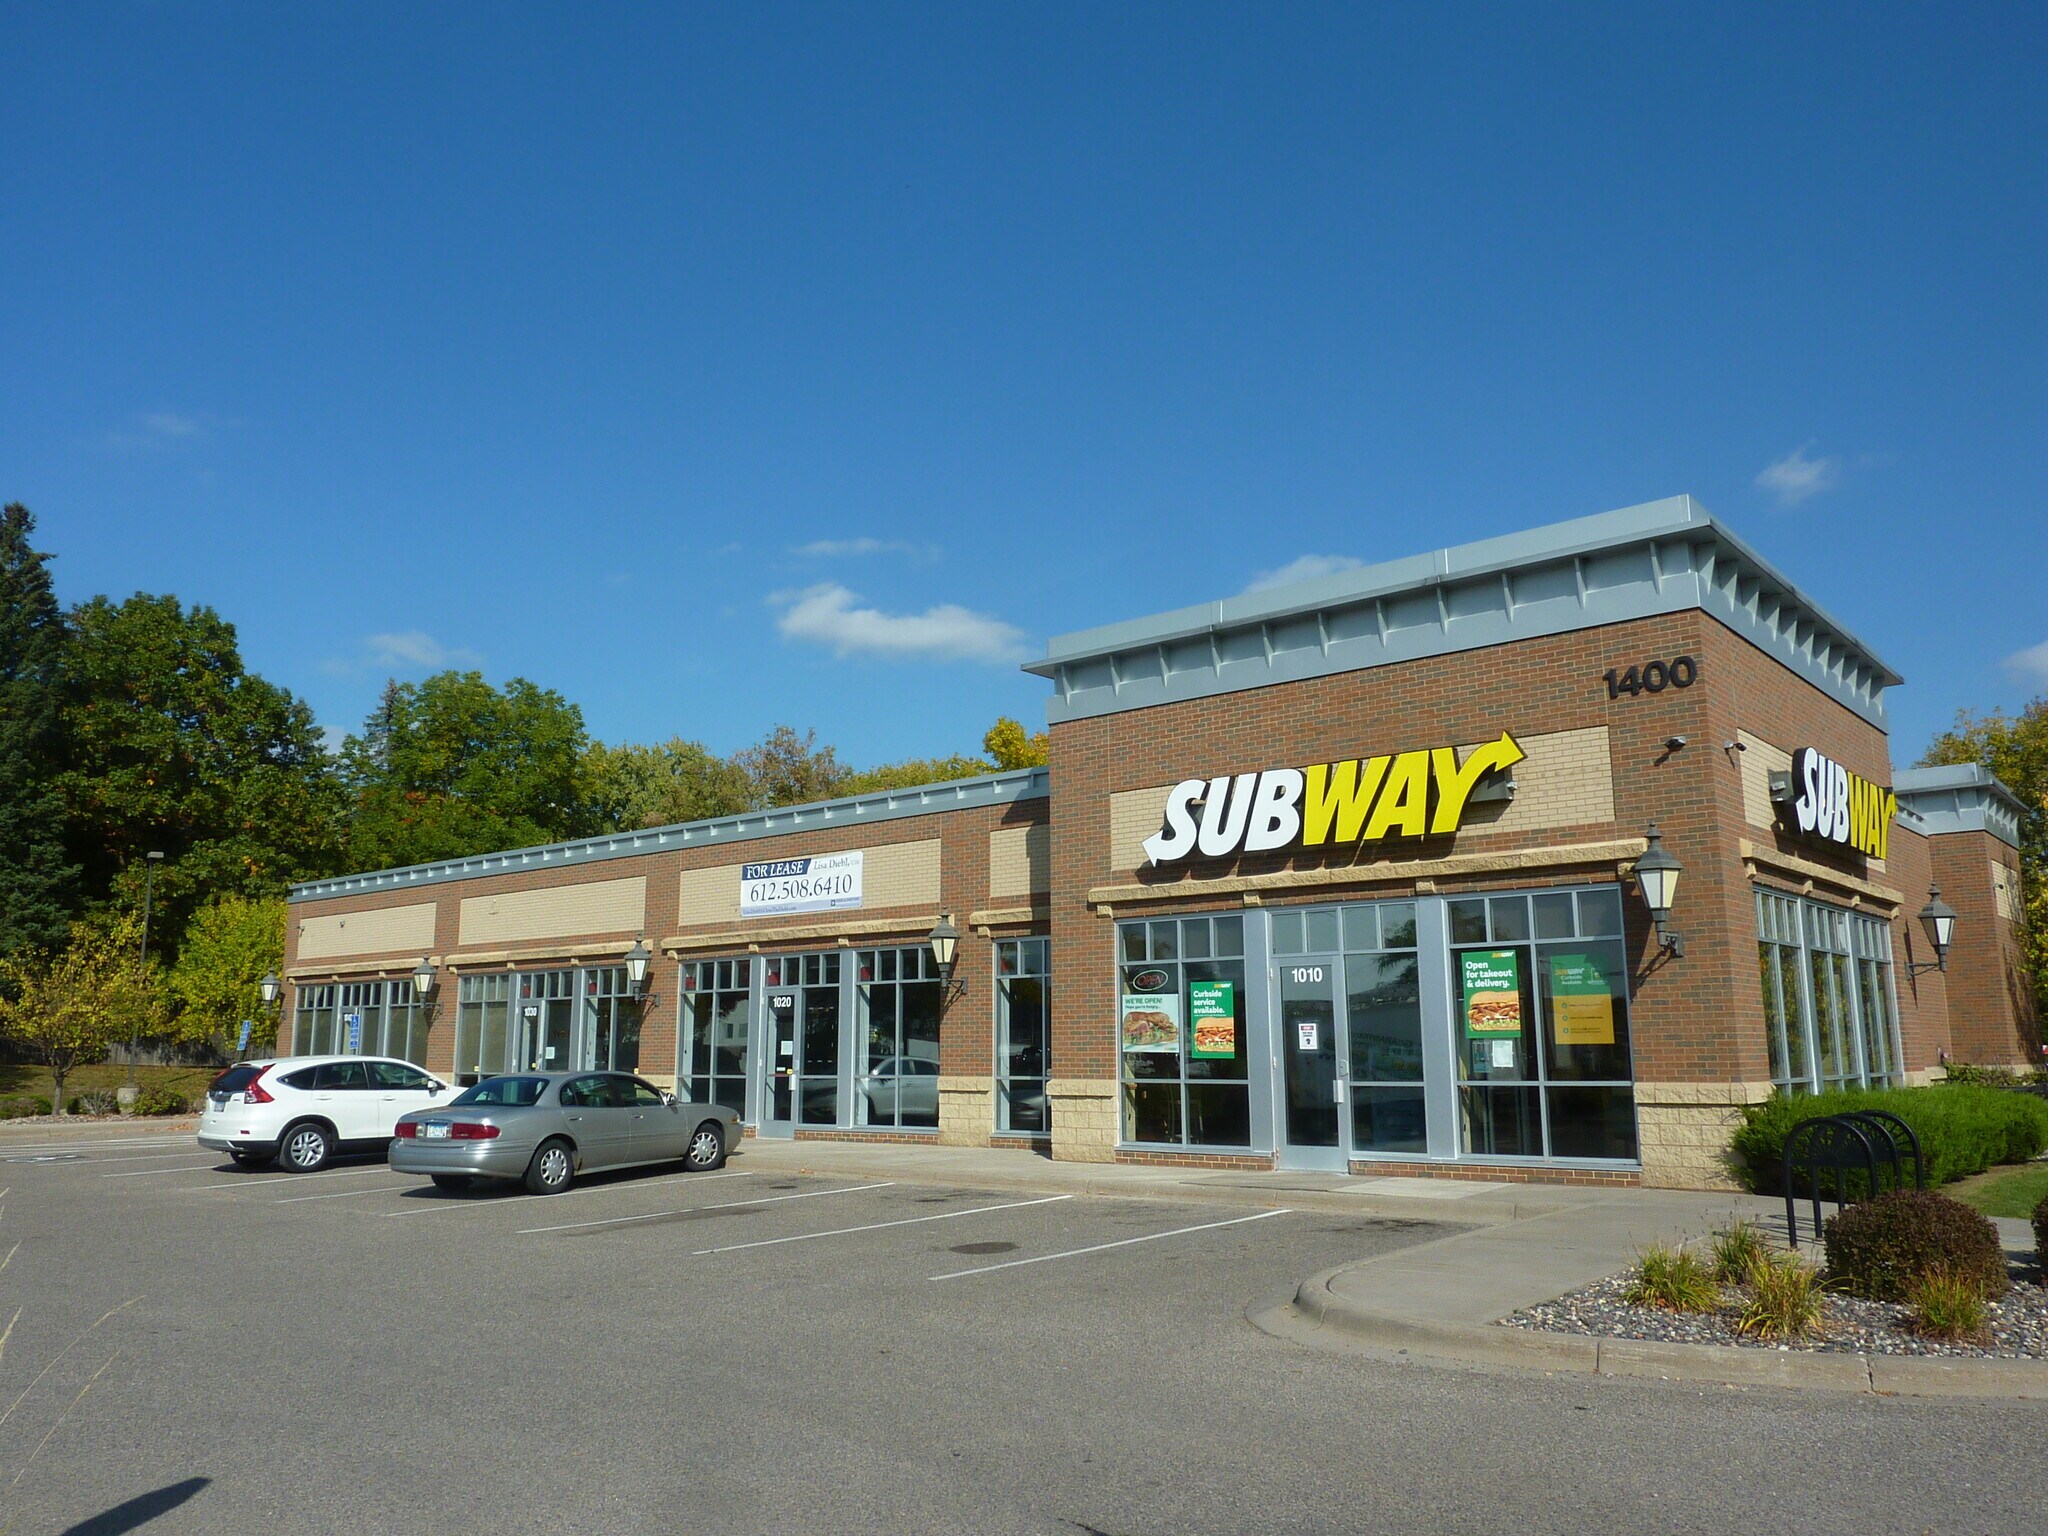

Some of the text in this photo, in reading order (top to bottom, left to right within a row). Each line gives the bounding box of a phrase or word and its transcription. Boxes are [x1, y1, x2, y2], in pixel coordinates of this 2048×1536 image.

[1602, 655, 1698, 700] 1400
[1141, 730, 1527, 867] SUBWAY
[1795, 746, 1897, 860] SUBWAY
[746, 860, 804, 879] FOR LEASE
[814, 860, 828, 870] Lisa
[750, 873, 852, 902] 612.508.6410
[1465, 961, 1488, 970] Open
[1291, 967, 1323, 983] 1010
[1466, 969, 1513, 979] for takeout
[1466, 979, 1510, 988] & delivery.
[1193, 990, 1223, 998] Curbside
[773, 996, 792, 1008] 1020
[1193, 998, 1216, 1006] service
[524, 1007, 537, 1016] 1030
[1193, 1006, 1226, 1014] available.
